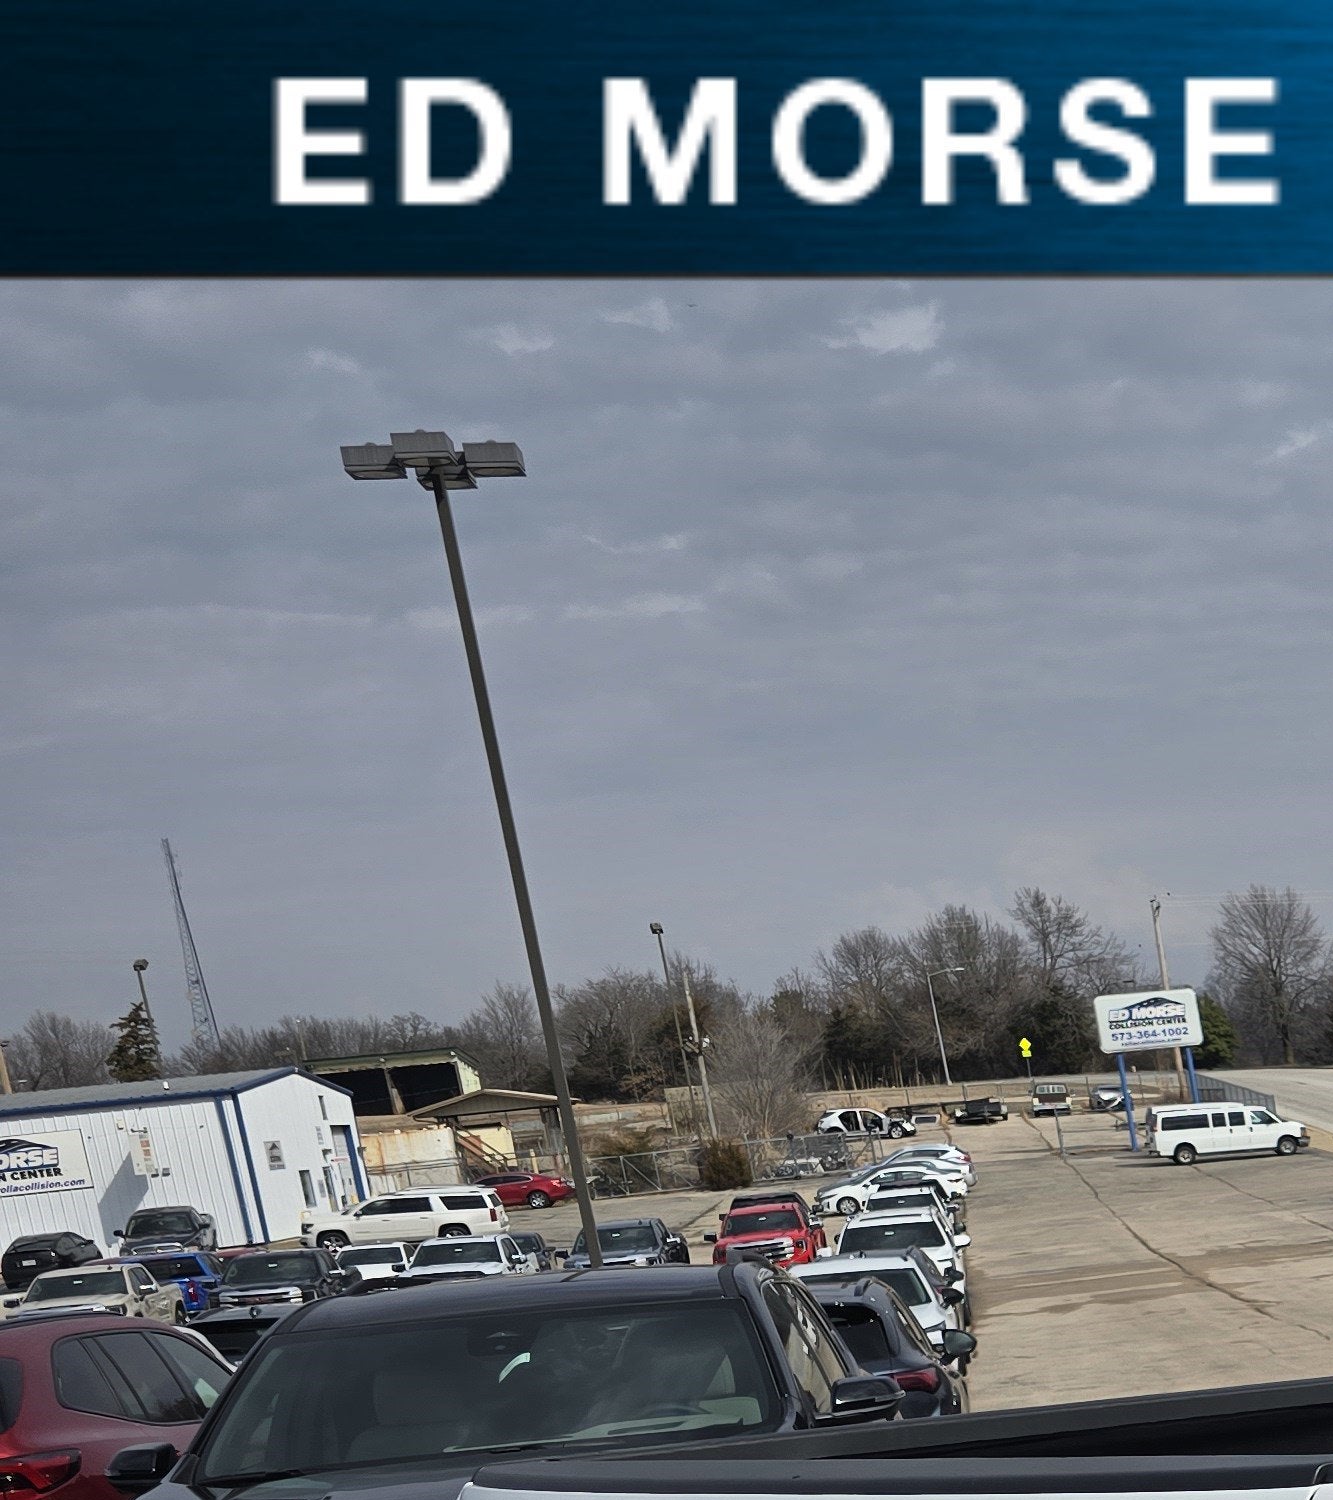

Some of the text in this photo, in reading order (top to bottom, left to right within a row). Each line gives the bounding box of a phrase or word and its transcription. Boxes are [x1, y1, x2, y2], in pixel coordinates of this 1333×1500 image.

[1109, 1003, 1185, 1022] ED MORSE
[1109, 1017, 1186, 1030] COLLISION CENTER
[1111, 1027, 1189, 1041] 573-364-1002
[10, 1167, 63, 1181] CENTER
[0, 1179, 85, 1194] ollacollision.com
